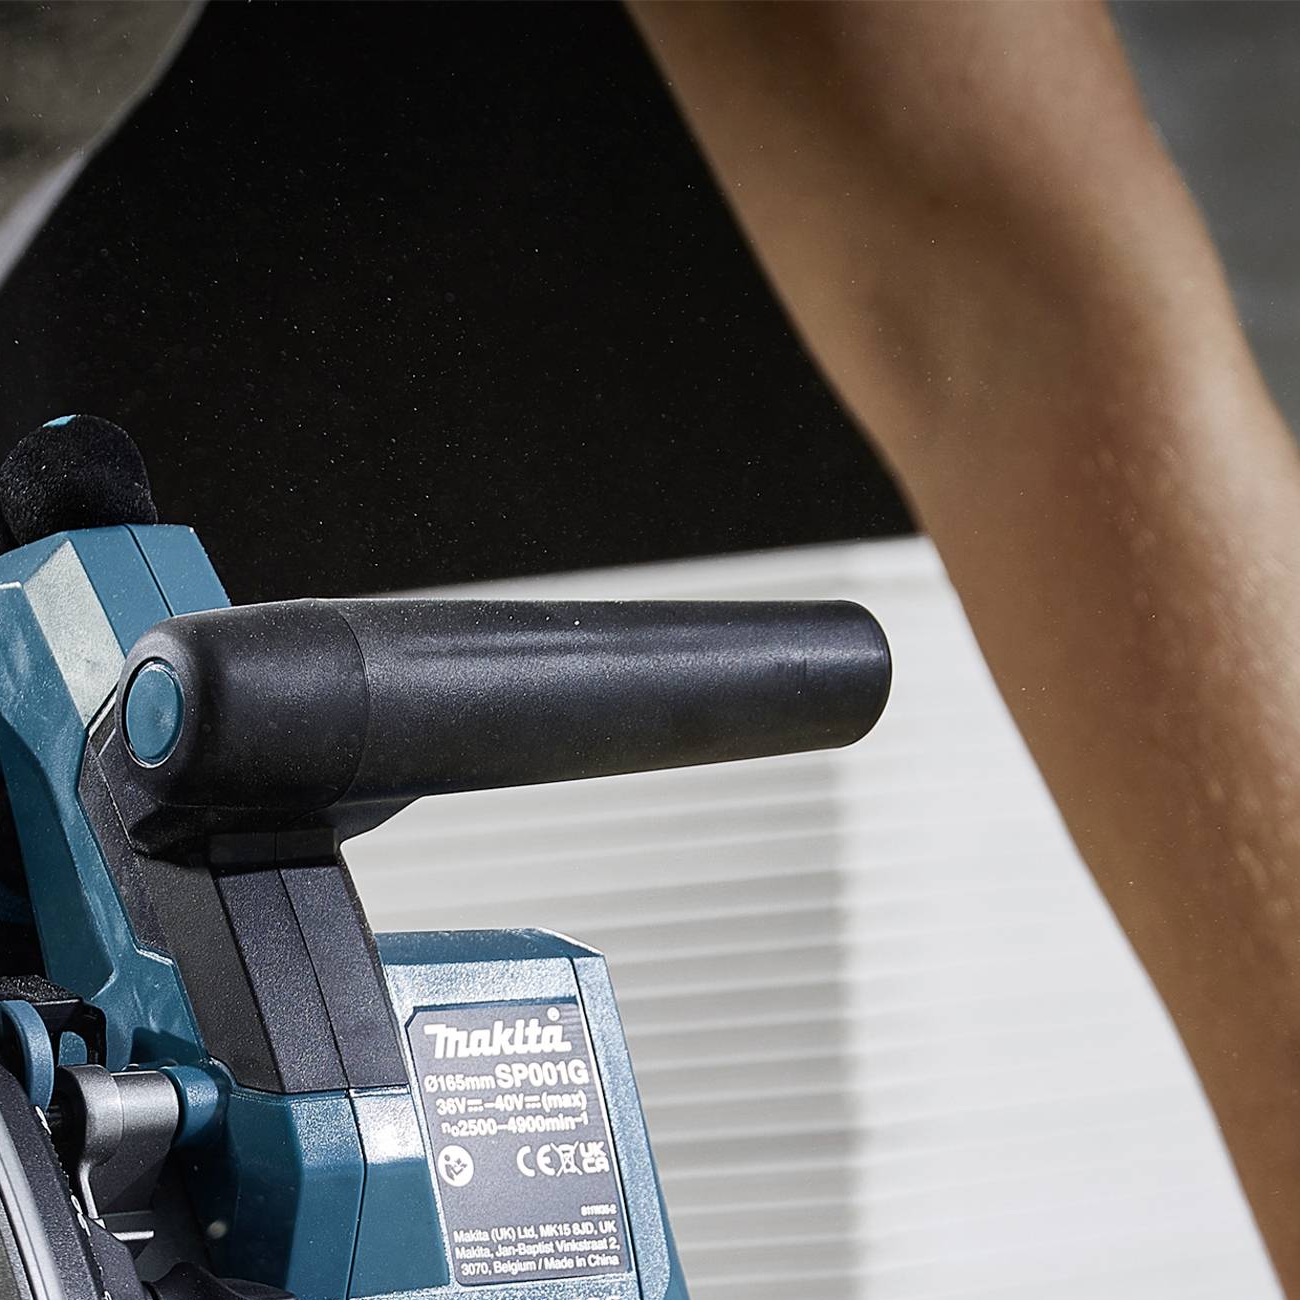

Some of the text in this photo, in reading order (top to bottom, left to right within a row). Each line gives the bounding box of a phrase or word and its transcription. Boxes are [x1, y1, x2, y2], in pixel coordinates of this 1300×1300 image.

[495, 1058, 590, 1088] SP001G
[453, 1229, 490, 1244] Makita
[491, 1227, 516, 1242] (UK)
[540, 1223, 571, 1237] MK15
[599, 1220, 617, 1234] UK
[493, 1259, 537, 1275] Belgium
[544, 1256, 575, 1271] Made
[575, 1255, 587, 1267] in
[587, 1252, 620, 1267] China
